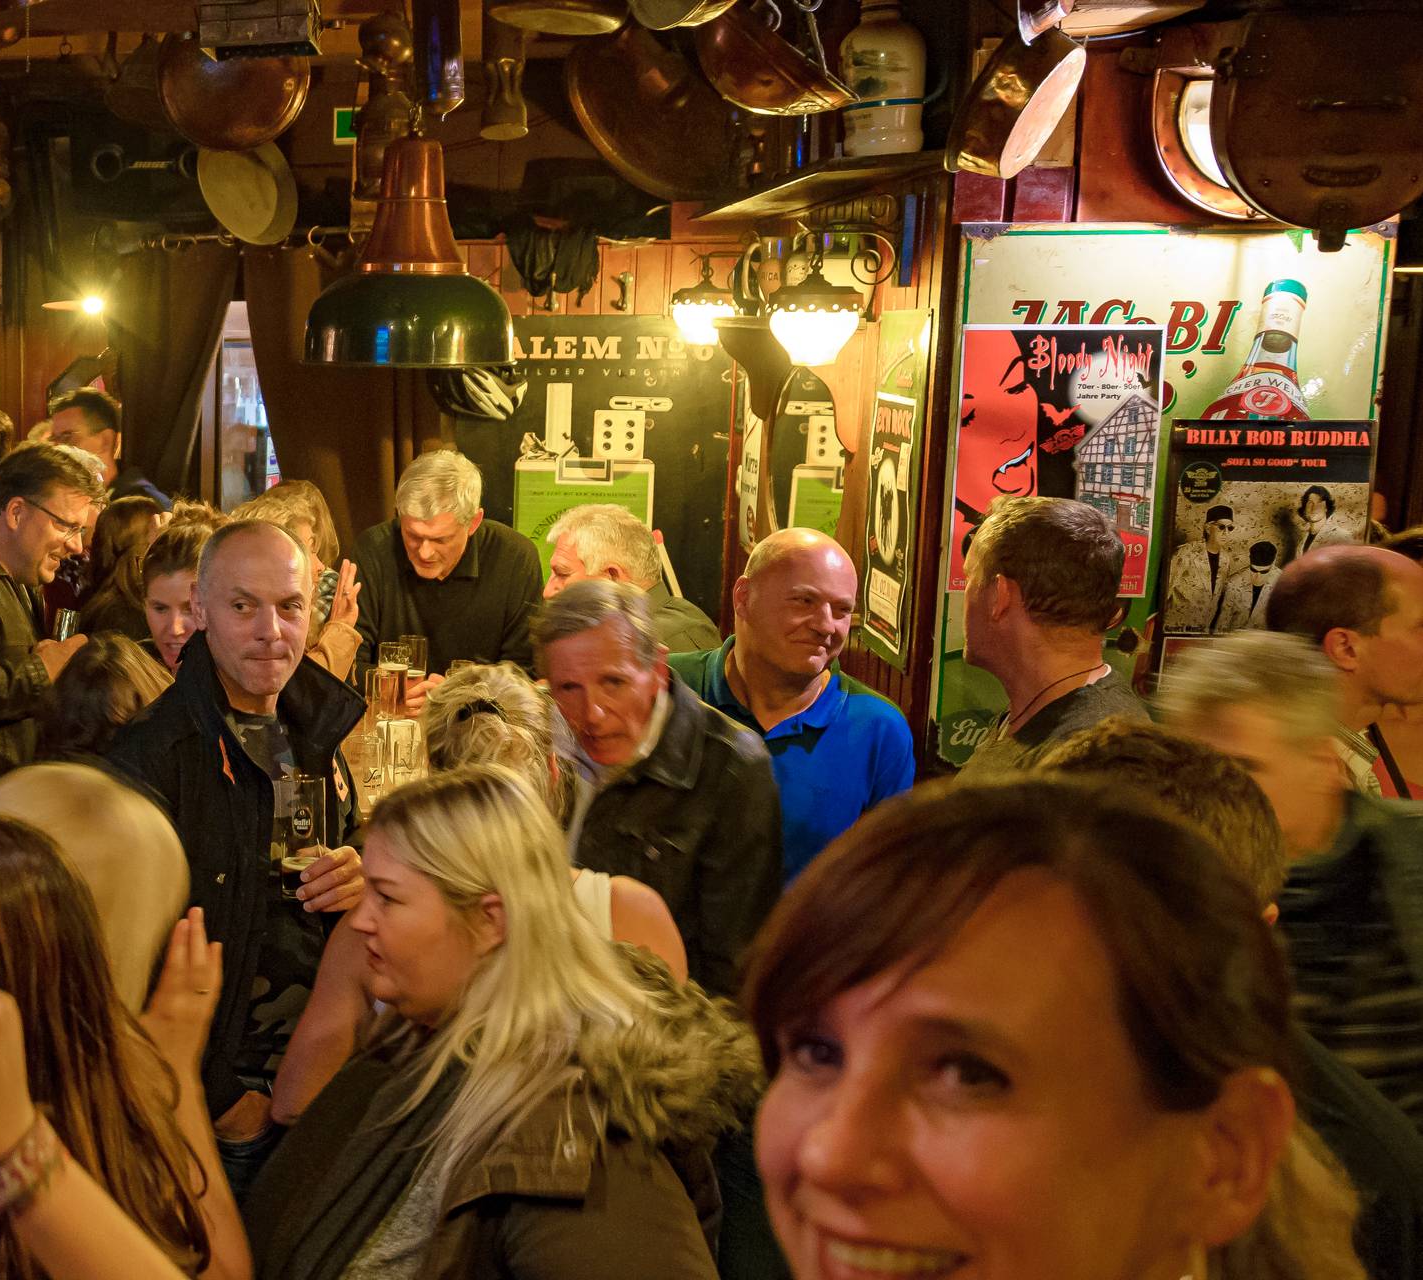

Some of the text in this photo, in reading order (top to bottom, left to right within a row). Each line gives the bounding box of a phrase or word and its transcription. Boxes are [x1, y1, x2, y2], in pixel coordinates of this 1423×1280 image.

[514, 336, 621, 360] ALEM
[1028, 335, 1154, 390] Bloody Night
[1100, 393, 1122, 401] Party
[1186, 429, 1370, 447] BILLY BOB BUDDHA
[1253, 458, 1265, 467] SO
[1301, 458, 1327, 468] TOUR
